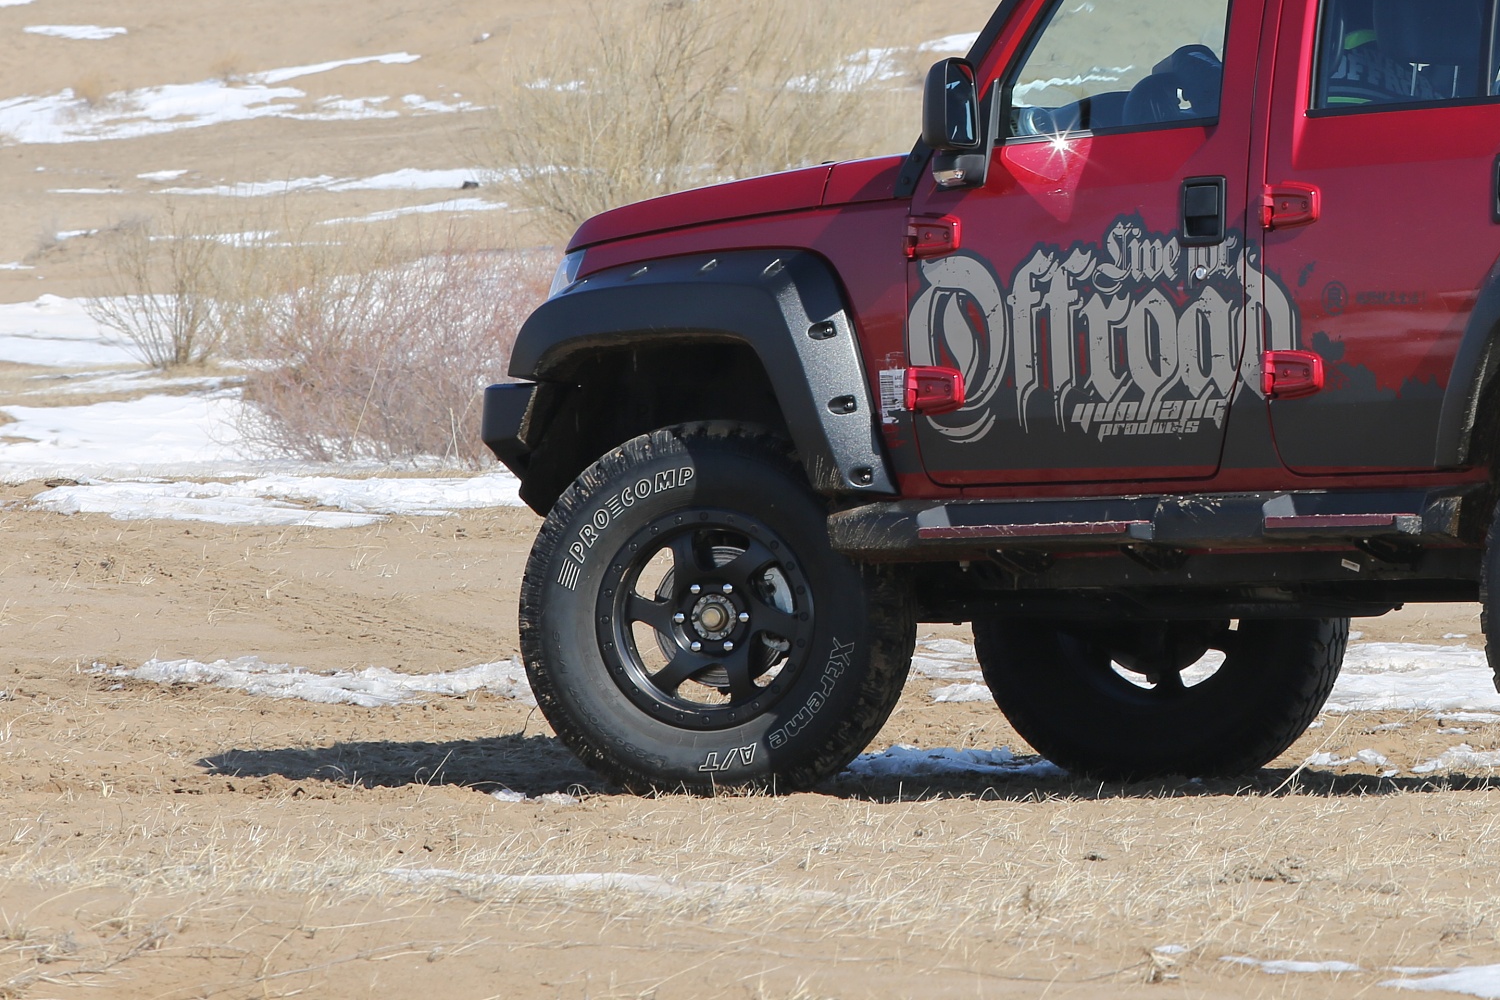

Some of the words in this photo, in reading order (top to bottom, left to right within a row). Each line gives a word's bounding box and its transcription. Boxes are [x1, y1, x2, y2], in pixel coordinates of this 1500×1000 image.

[1092, 221, 1181, 295] Live
[768, 637, 855, 750] Xtreme
[698, 742, 758, 772] A/T
